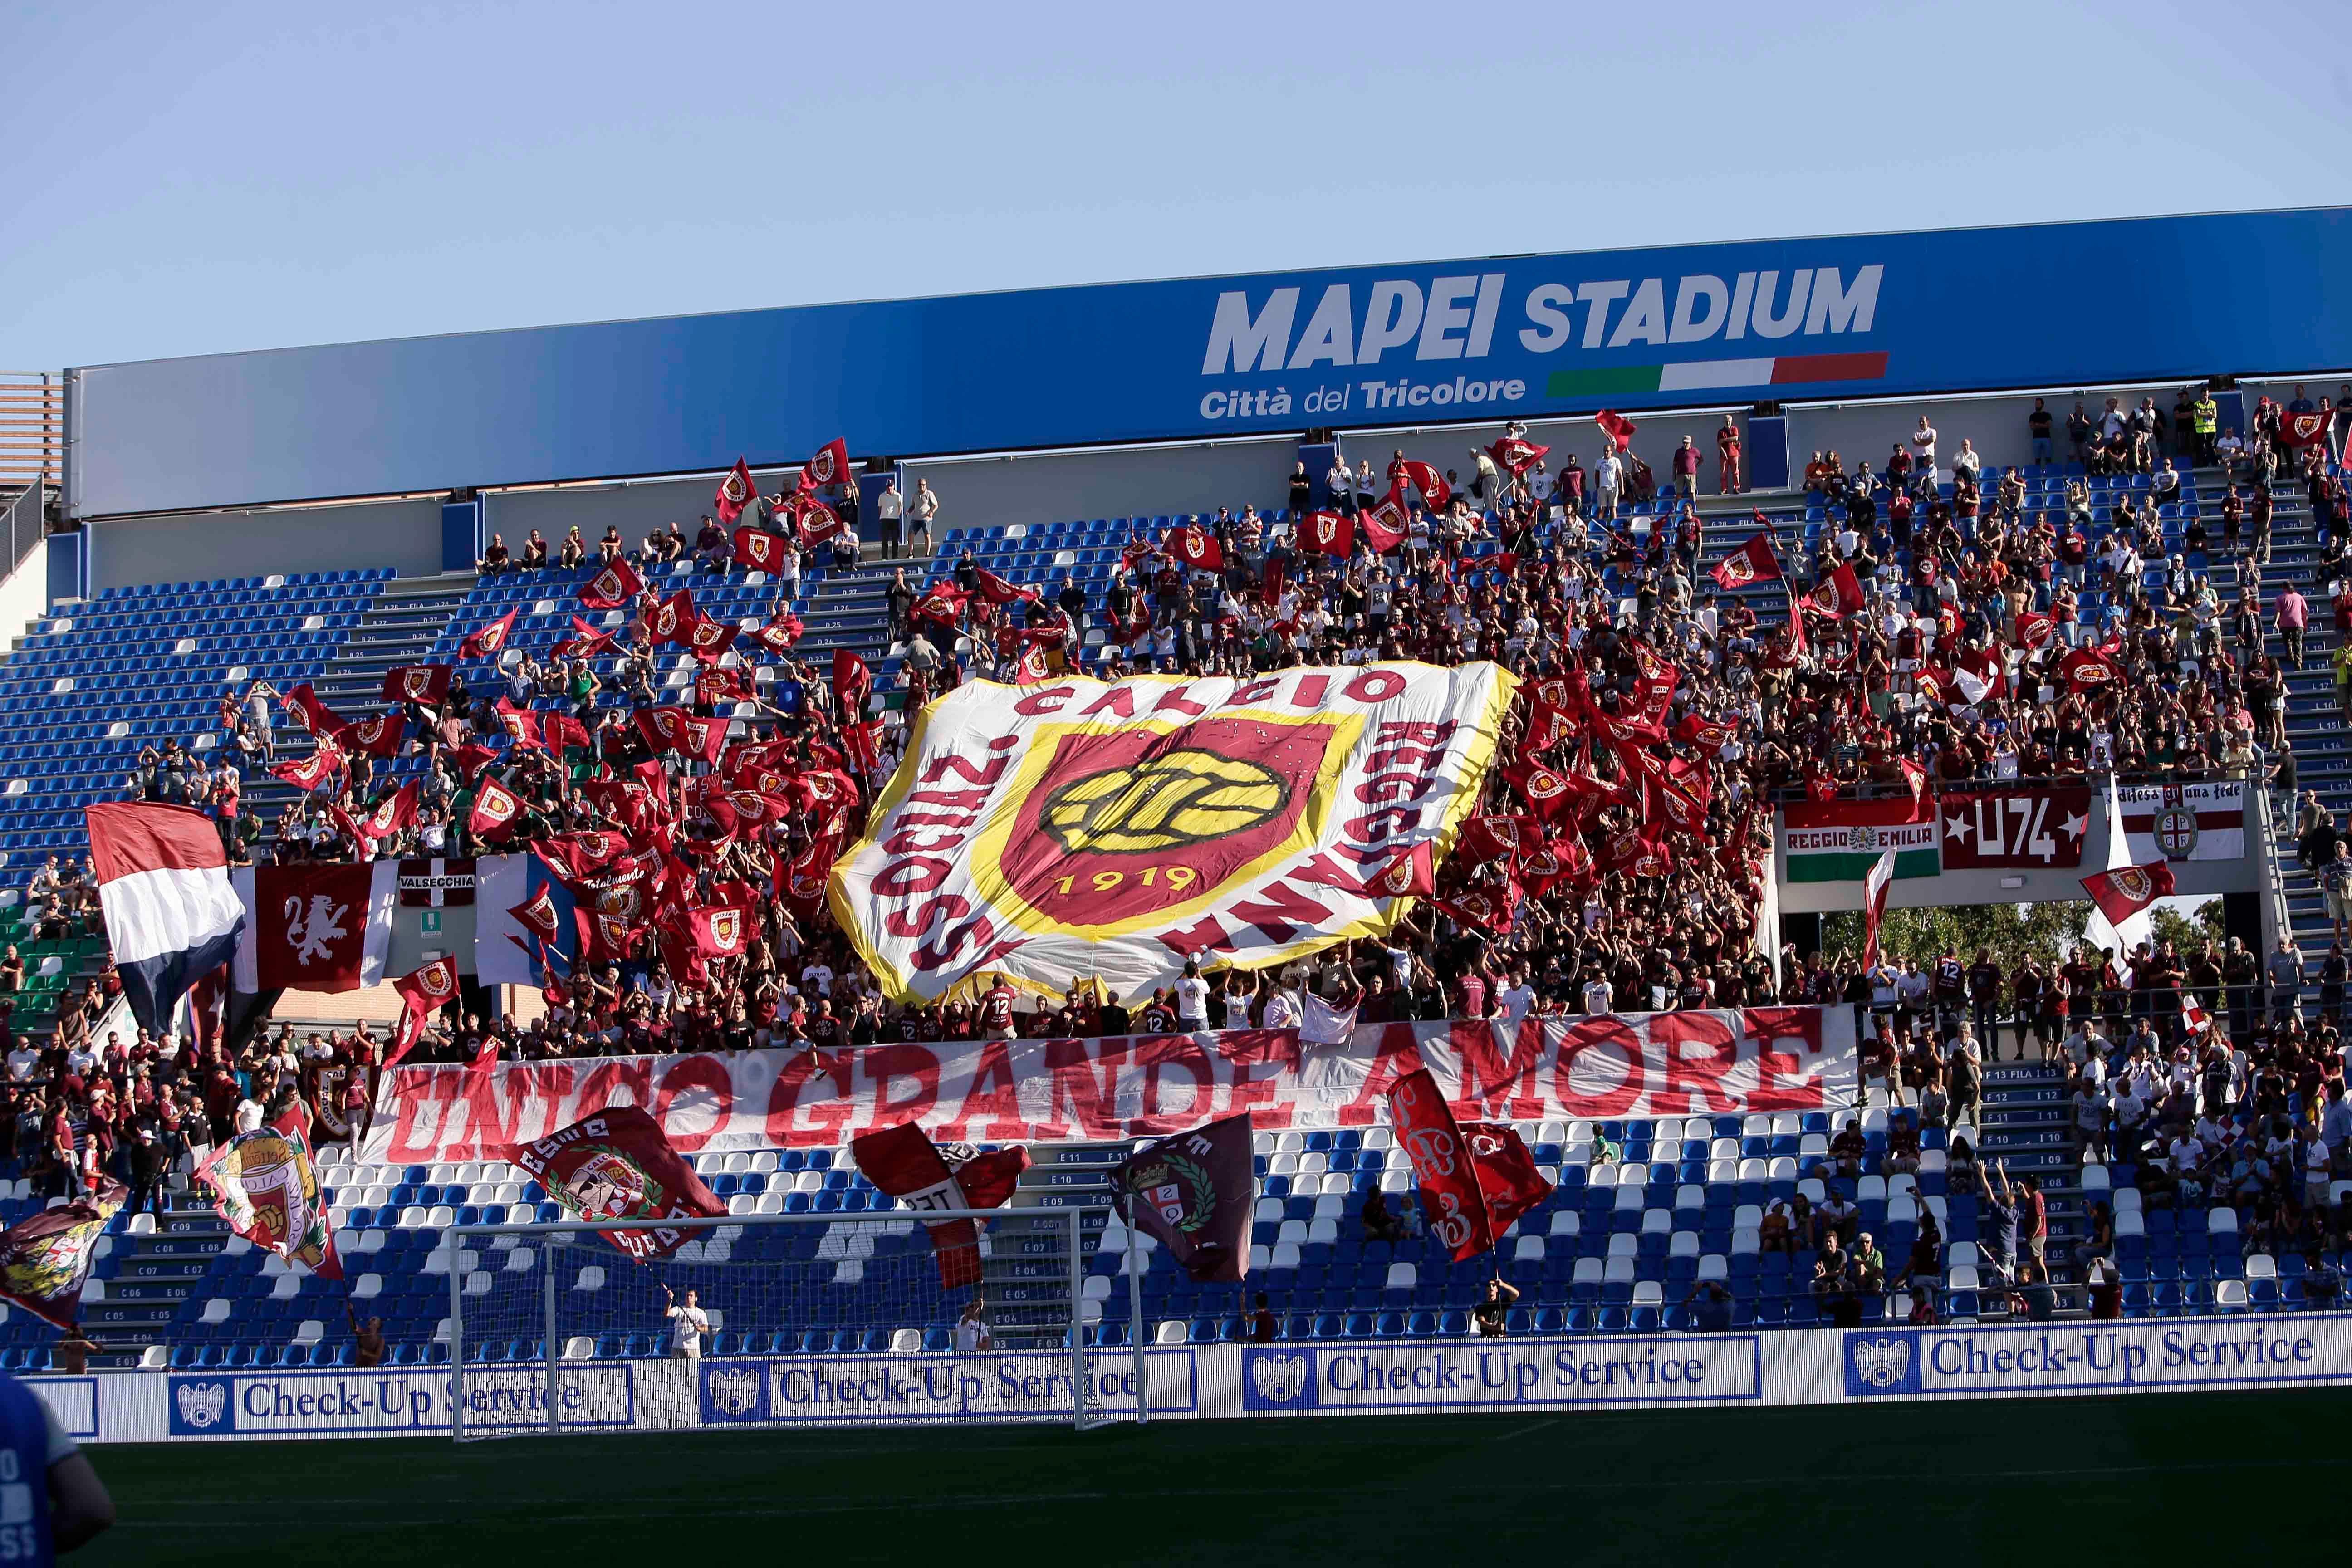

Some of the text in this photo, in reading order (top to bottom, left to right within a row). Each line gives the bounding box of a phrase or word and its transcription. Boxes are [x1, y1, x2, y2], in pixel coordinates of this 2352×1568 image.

[1201, 265, 1884, 375] MAPEI STADIUM
[1200, 377, 1525, 420] Città del Tricolore
[1014, 670, 1407, 715] CALCIO
[1542, 681, 1559, 690] CALCIO
[2117, 787, 2159, 804] difesa
[2185, 787, 2209, 799] una
[2214, 783, 2240, 800] fede
[1975, 798, 2055, 862] U74
[2166, 818, 2185, 828] S P
[1788, 828, 1932, 848] REGGIO EMILIA
[2166, 836, 2186, 846] Q R
[401, 877, 474, 887] VALSECCHIA
[583, 867, 645, 890] Totalmente
[1054, 867, 1196, 895] 1919
[1941, 963, 1959, 980] 12
[992, 999, 1009, 1014] 12
[902, 1025, 915, 1039] 12
[1147, 1016, 1162, 1032] 12
[385, 1009, 1824, 1163] UNICO GRANDE AMORE
[1987, 1093, 2008, 1102] F 12
[1988, 1114, 2008, 1122] F 11
[1988, 1136, 2009, 1144] F 10
[586, 1153, 616, 1171] CALCIO
[1051, 1197, 1063, 1205] 09
[2050, 1202, 2062, 1211] 07
[1092, 1219, 1103, 1227] 08
[2051, 1225, 2063, 1234] 06
[2053, 1274, 2066, 1283] 04
[105, 1312, 124, 1320] C 05
[1931, 1328, 2313, 1382] Check-Up Service
[1328, 1349, 1704, 1400] Check-Up Service
[780, 1358, 1139, 1412] Check-Up Service
[244, 1380, 582, 1425] Check-Up Service
